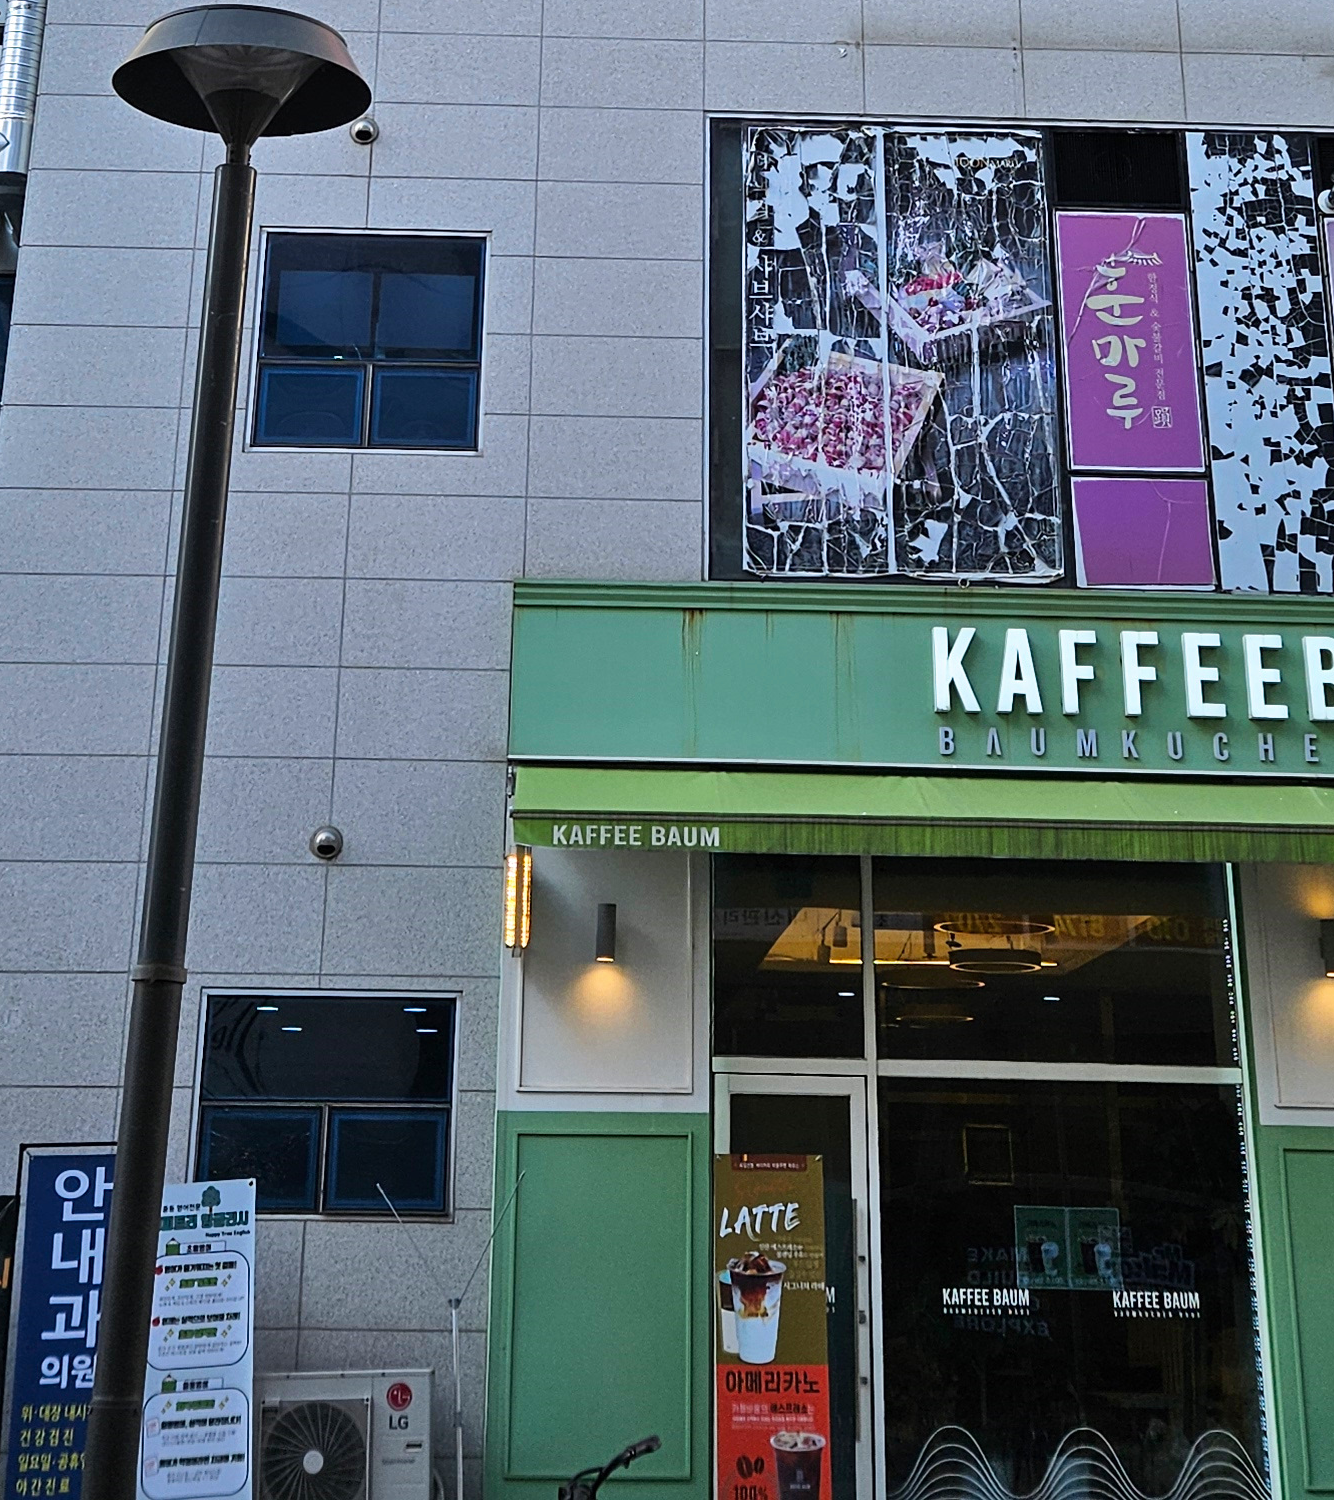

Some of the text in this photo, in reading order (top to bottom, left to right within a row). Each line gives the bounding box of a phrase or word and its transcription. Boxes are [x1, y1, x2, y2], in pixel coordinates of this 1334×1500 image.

[552, 823, 721, 849] KAFFEE BAUM
[719, 1201, 802, 1243] LATTE
[942, 1287, 1030, 1307] KAFFEE BAUM
[1113, 1290, 1200, 1310] KAFFEE BAUM
[725, 1369, 821, 1395] 아메리카노
[64, 1402, 93, 1423] 내시
[388, 1413, 410, 1431] LG
